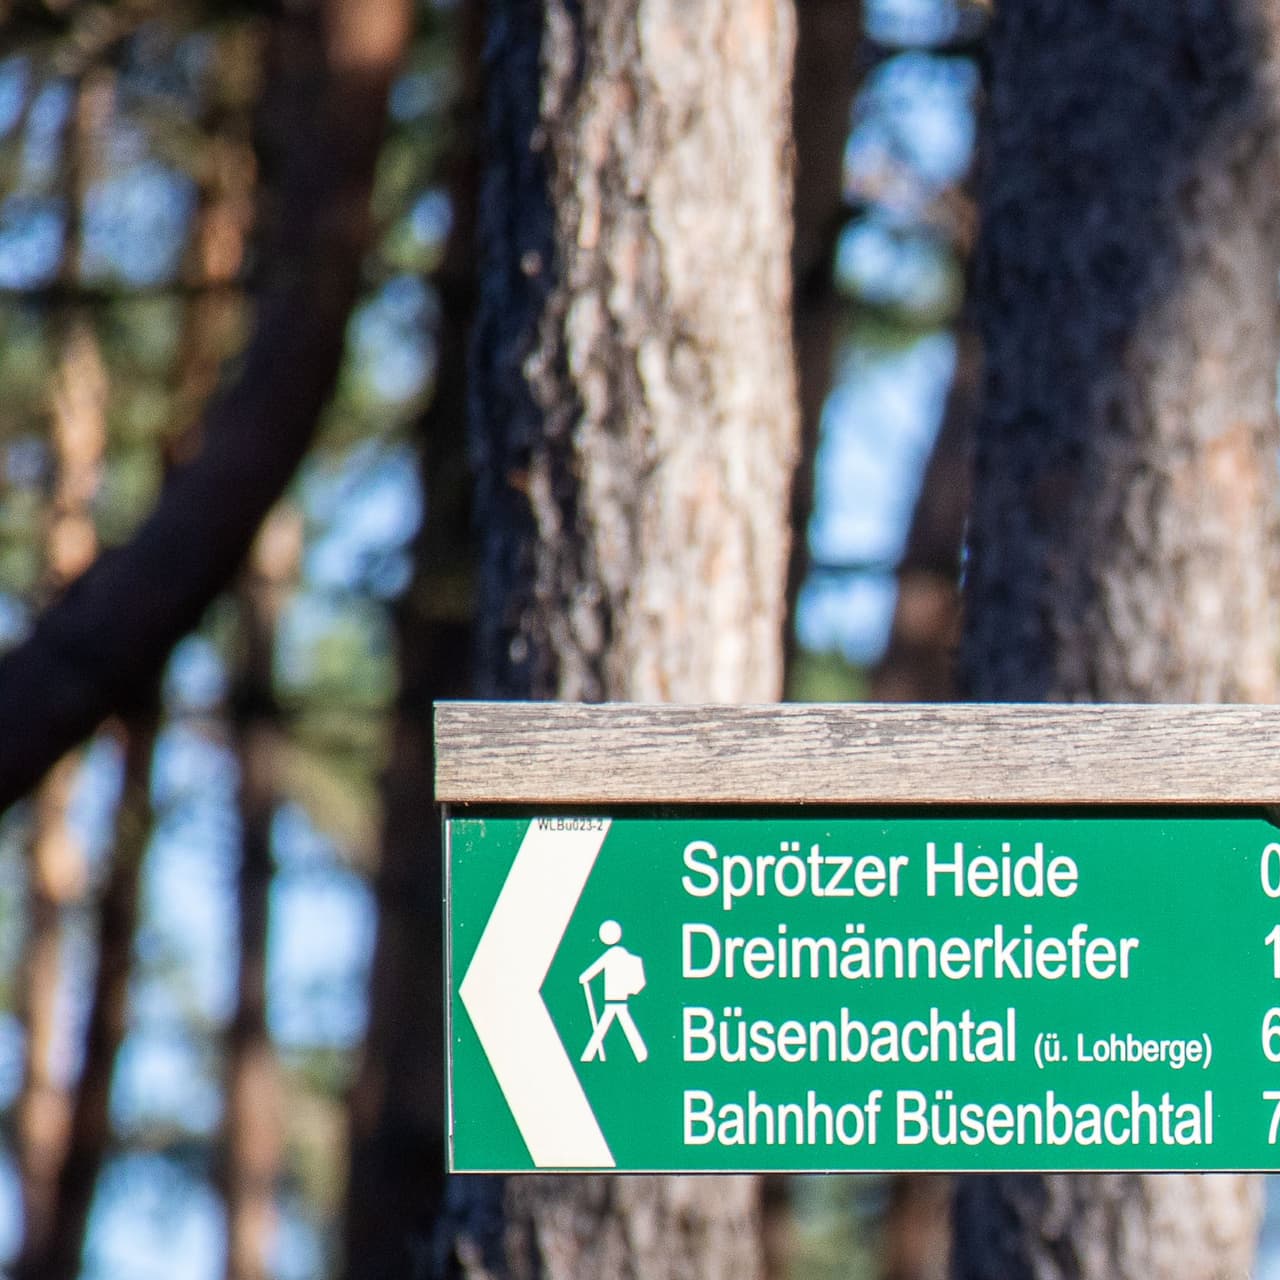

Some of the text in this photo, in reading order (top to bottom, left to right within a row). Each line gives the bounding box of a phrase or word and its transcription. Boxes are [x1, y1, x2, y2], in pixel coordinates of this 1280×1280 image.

[682, 841, 908, 910] Sprötzer
[927, 843, 1078, 898] Heide
[683, 924, 1139, 979] Dreimännerkiefer
[683, 1007, 1015, 1062] Büsenbachtal
[1035, 1033, 1067, 1068] (ü.
[1078, 1034, 1212, 1069] Lohberge)
[684, 1090, 882, 1145] Bahnhof
[897, 1090, 1212, 1145] Büsenbachtal
